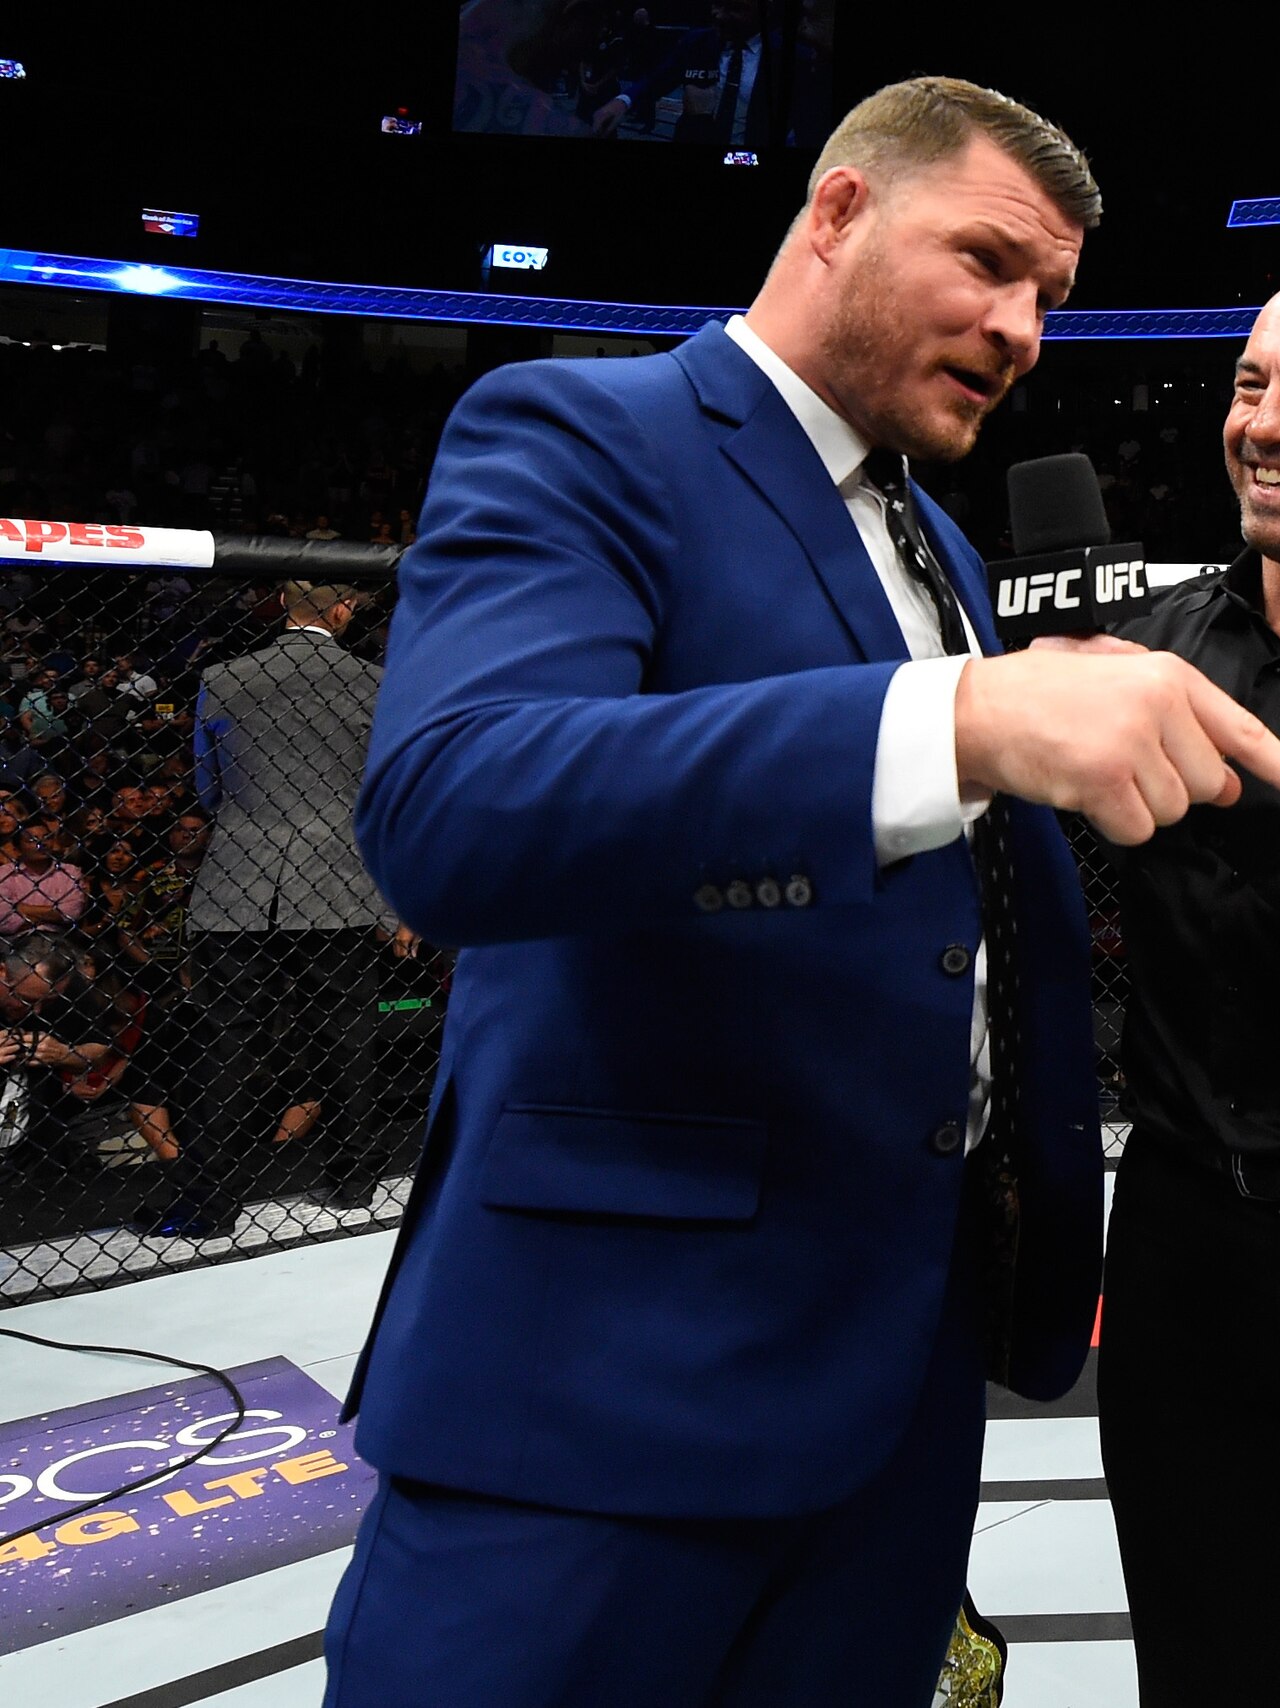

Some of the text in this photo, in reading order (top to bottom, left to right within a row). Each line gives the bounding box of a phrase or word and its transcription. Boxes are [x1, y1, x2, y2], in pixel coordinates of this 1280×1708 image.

[997, 568, 1082, 617] UFC
[1095, 560, 1145, 603] UFC
[162, 1449, 349, 1517] LTE
